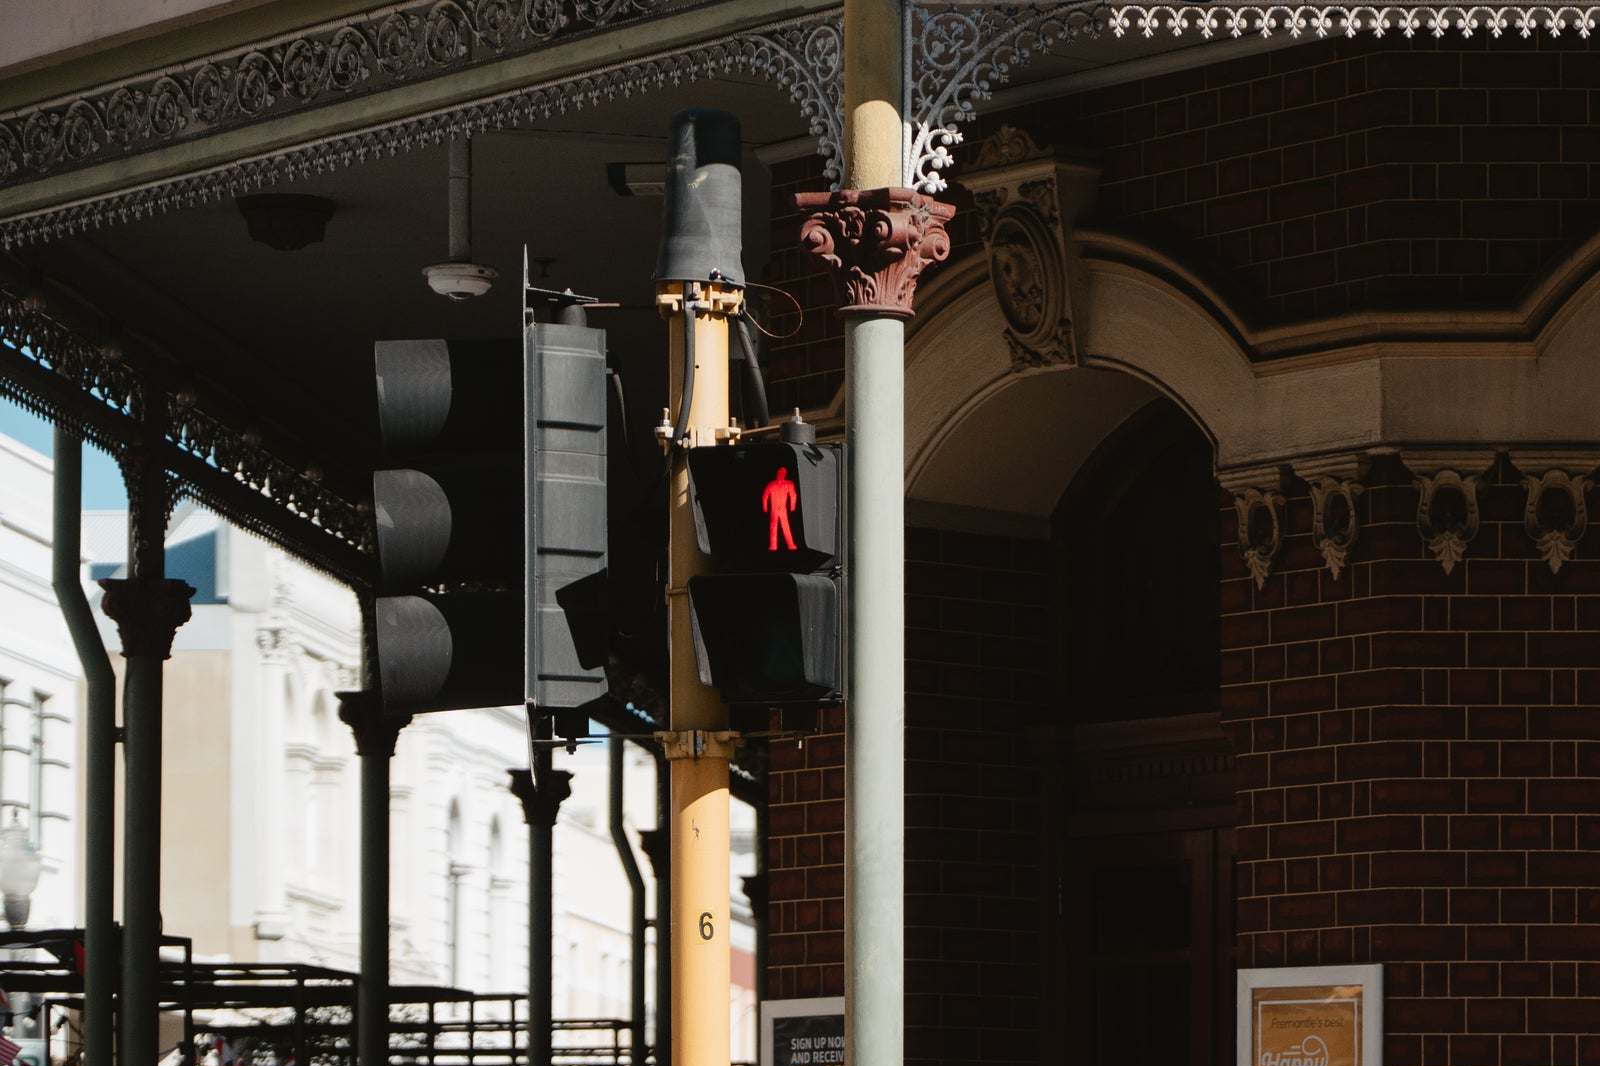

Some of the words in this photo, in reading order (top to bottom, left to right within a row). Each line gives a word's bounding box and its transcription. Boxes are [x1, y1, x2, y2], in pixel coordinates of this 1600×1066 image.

[699, 912, 714, 940] 6
[1271, 1017, 1324, 1029] Fremantle's
[1324, 1018, 1344, 1028] best
[791, 1038, 812, 1050] SIGN
[814, 1037, 826, 1049] UP
[791, 1052, 810, 1064] AND
[813, 1051, 844, 1063] RECEIV
